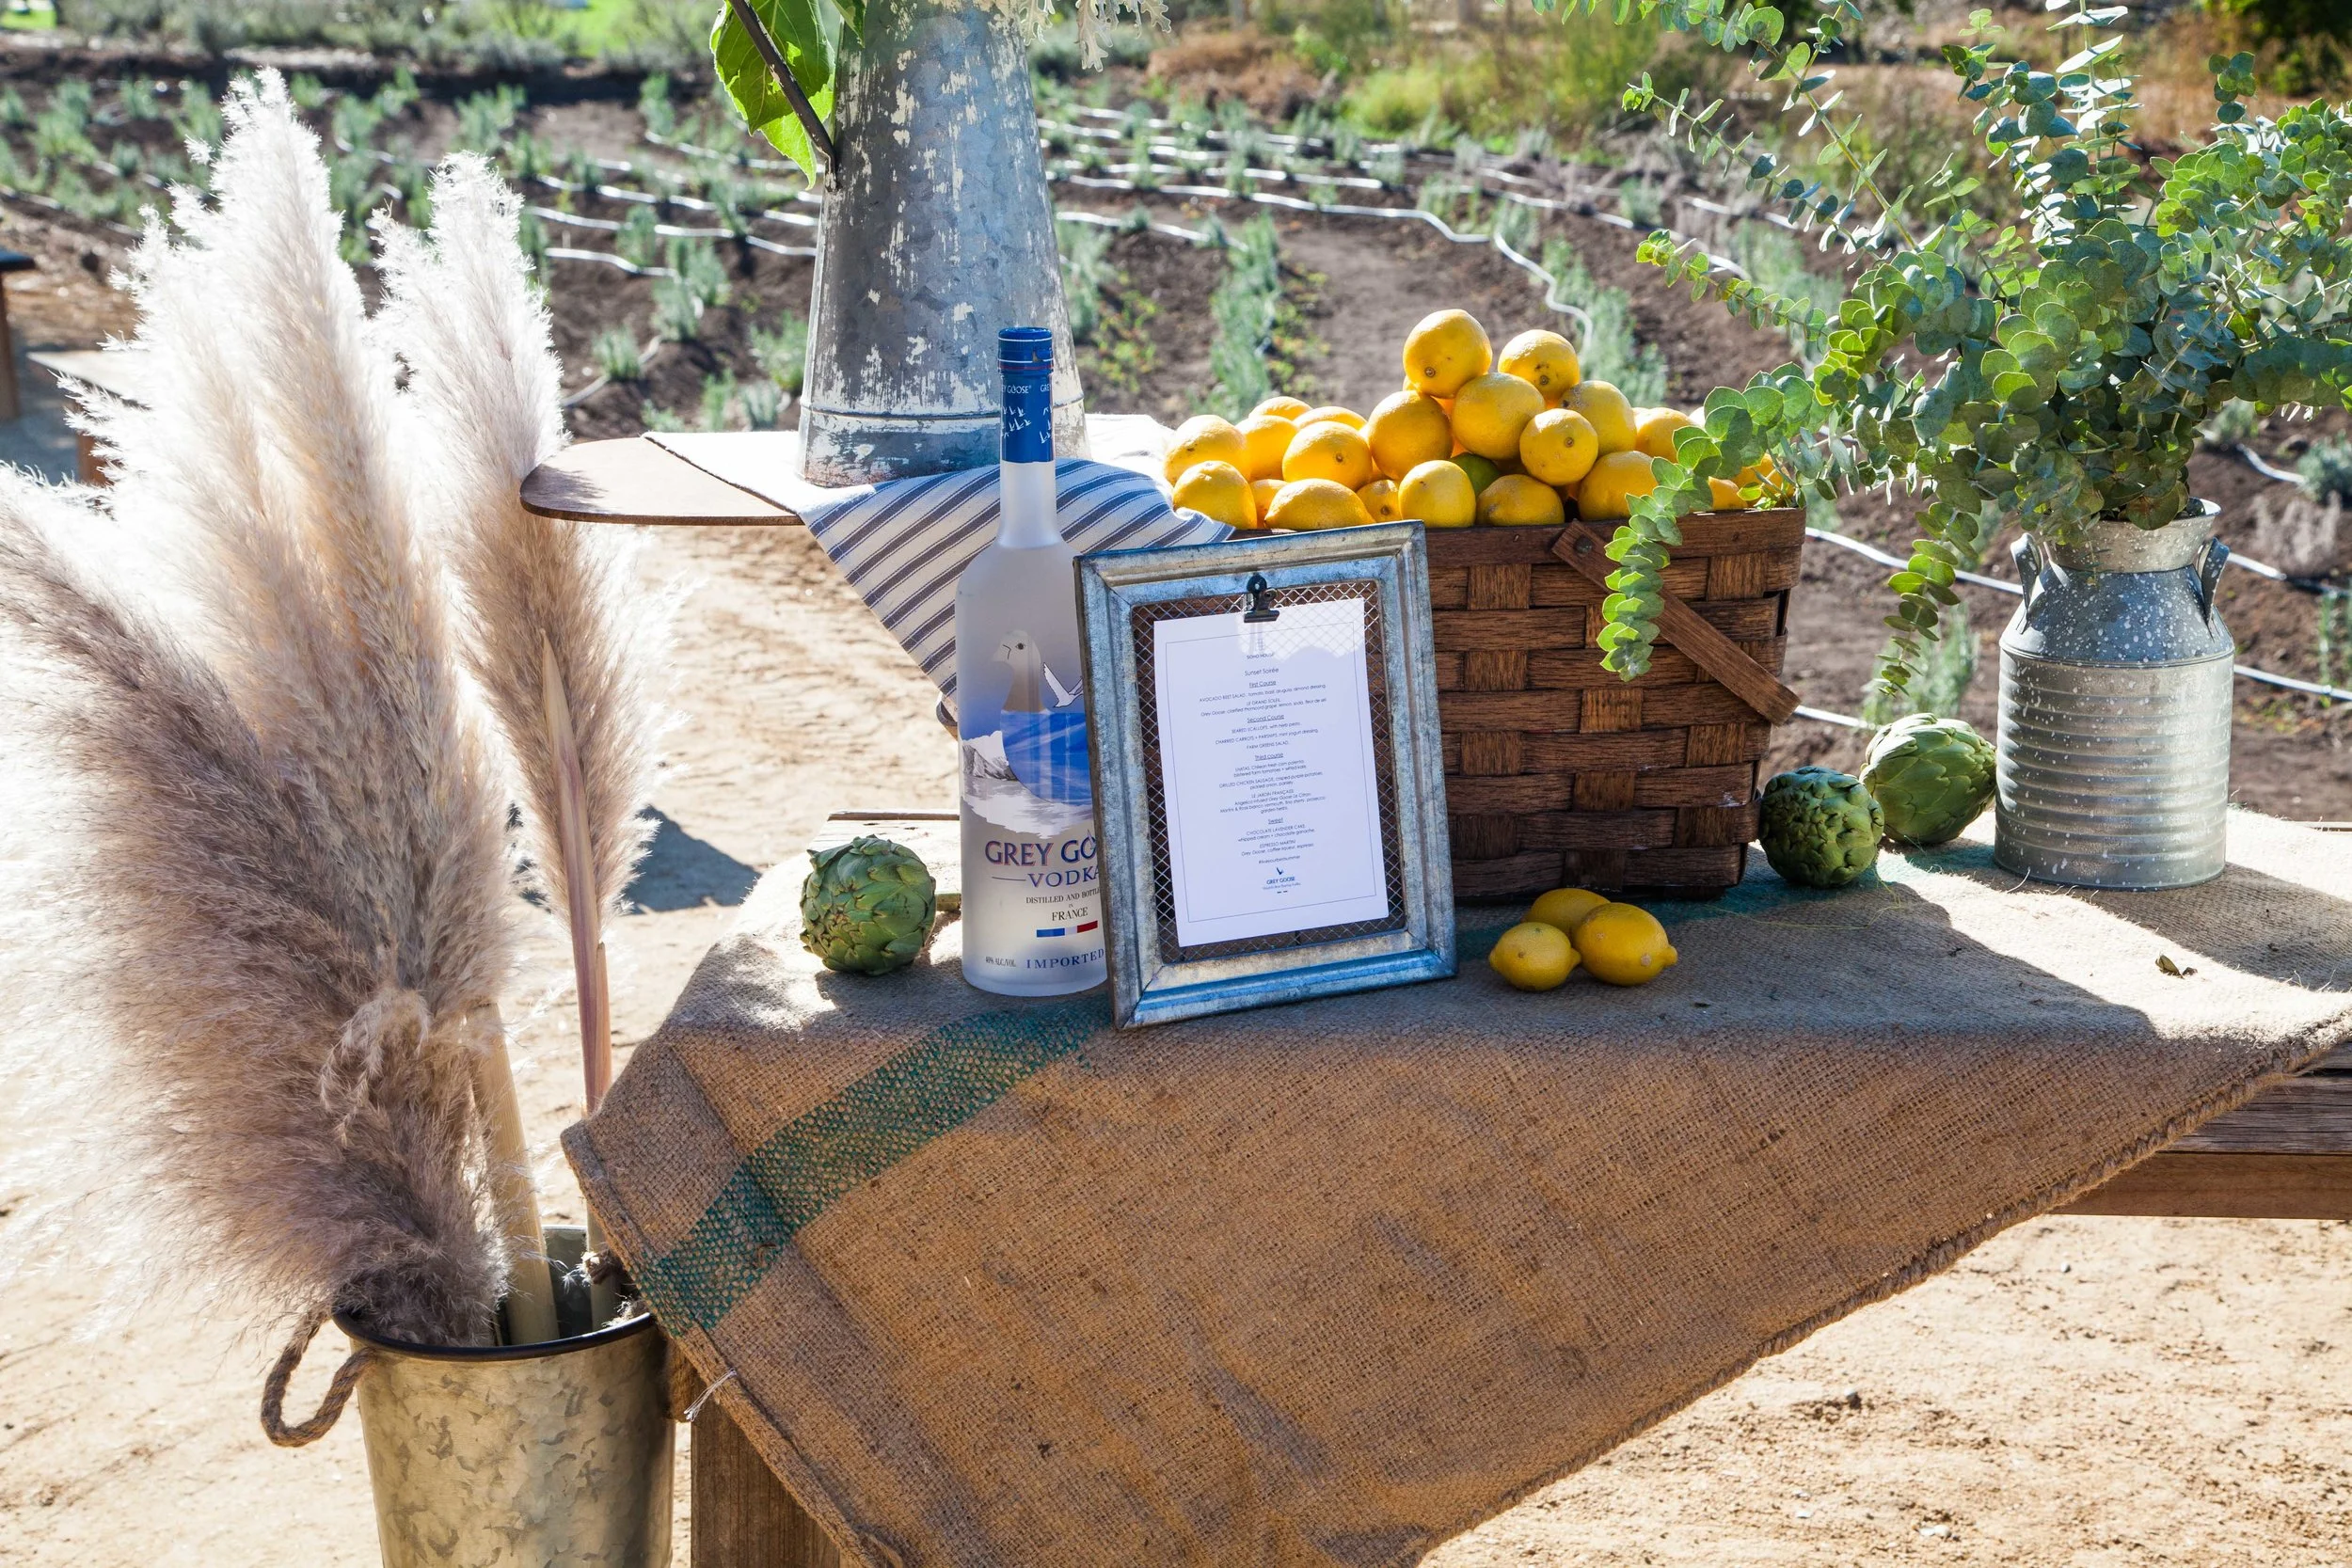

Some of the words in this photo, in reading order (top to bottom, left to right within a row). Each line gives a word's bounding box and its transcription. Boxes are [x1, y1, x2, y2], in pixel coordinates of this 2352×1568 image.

[1007, 385, 1029, 394] GOOSE
[1040, 384, 1051, 392] GRE
[985, 840, 1053, 866] GREY
[1066, 893, 1080, 901] AND
[1052, 907, 1089, 921] FRANCE
[1026, 948, 1104, 969] IMPORTED
